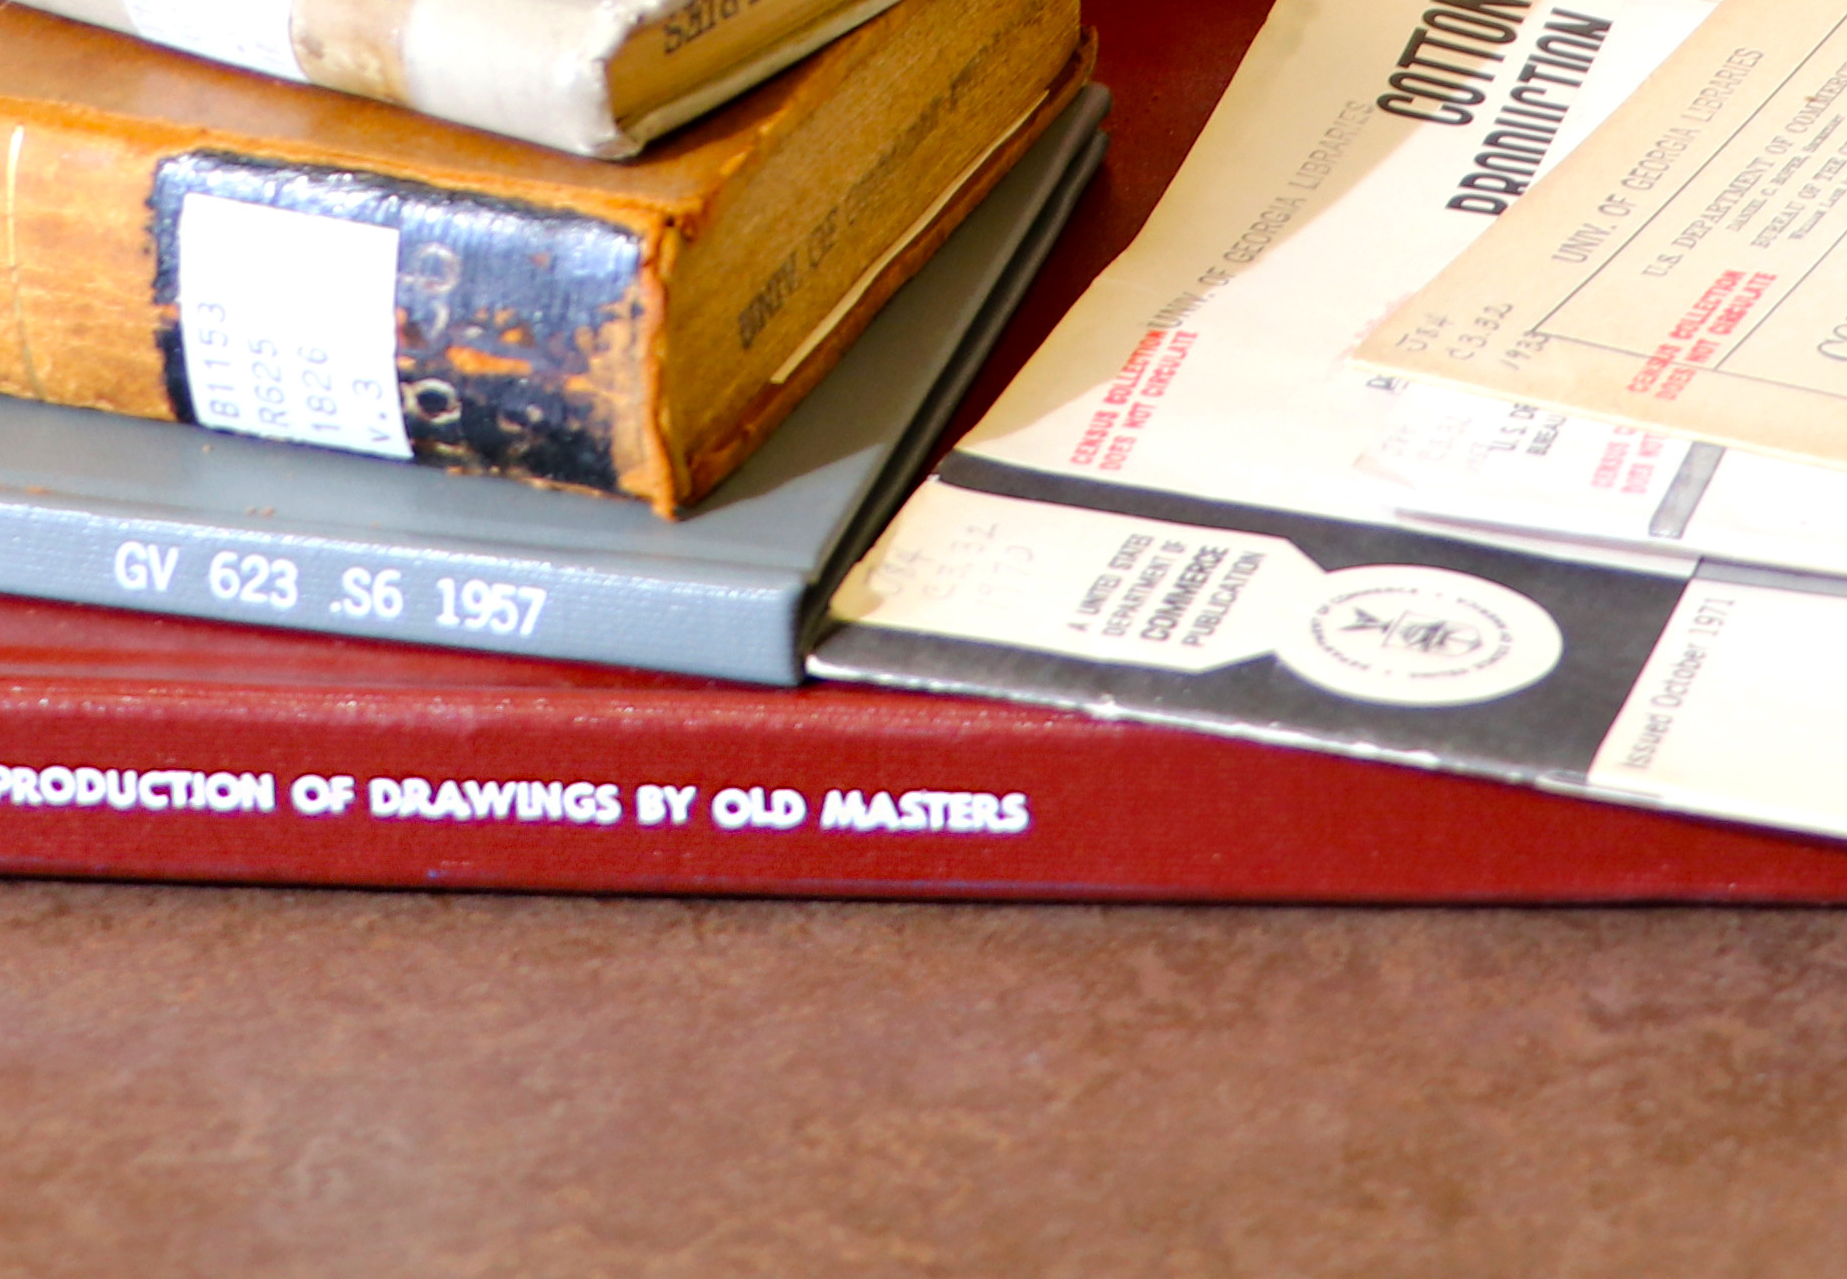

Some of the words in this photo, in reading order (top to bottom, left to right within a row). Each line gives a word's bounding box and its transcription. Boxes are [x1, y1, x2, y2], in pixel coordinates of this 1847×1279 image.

[1551, 217, 1616, 264] UNIV.
[1610, 191, 1639, 219] OF
[1635, 126, 1703, 193] GEORGIA
[1688, 46, 1765, 123] LIBRARIES
[1147, 280, 1216, 331] UNIV.
[1197, 264, 1235, 297] OF
[1222, 191, 1306, 266] GEORGIA
[1288, 98, 1374, 192] LIBRARIES
[1638, 250, 1687, 278] U.S.
[1668, 155, 1777, 251] DEPARTMENT
[1761, 135, 1799, 155] OF
[1747, 199, 1808, 249] BUREAU
[1792, 183, 1824, 200] OF
[197, 301, 241, 419] B1153
[1622, 343, 1684, 394] CENSUS
[1665, 267, 1749, 341] COLLECTION
[1649, 365, 1701, 401] DOES
[1680, 338, 1723, 364] NOT
[1704, 270, 1779, 336] CIRCULATE
[248, 338, 291, 429] R625
[300, 345, 341, 433] 1826
[1069, 409, 1117, 466] CENSUS
[1103, 329, 1168, 407] COLLECTION
[1099, 434, 1140, 472] DOES
[1126, 394, 1158, 430] NOT
[1143, 329, 1199, 401] CIRCULATE
[114, 539, 180, 594] GV
[207, 551, 301, 610] 623
[328, 567, 404, 621] .S6
[435, 577, 548, 637] 1957
[1076, 572, 1119, 617] UNITED
[1101, 558, 1166, 639] DEPARTMENT
[1162, 537, 1188, 557] OF
[1108, 532, 1155, 570] STATES
[1139, 543, 1231, 642] COMMERCE
[1181, 550, 1269, 647] PUBLICATION
[1067, 610, 1089, 632] A
[1619, 711, 1670, 769] Issued
[1649, 646, 1708, 714] October
[1688, 597, 1736, 639] 1971
[291, 773, 356, 818] OF
[368, 776, 622, 826] DRAWINGS
[634, 784, 696, 828] BY
[710, 787, 808, 832] OLD
[819, 790, 1031, 836] MASTERS
